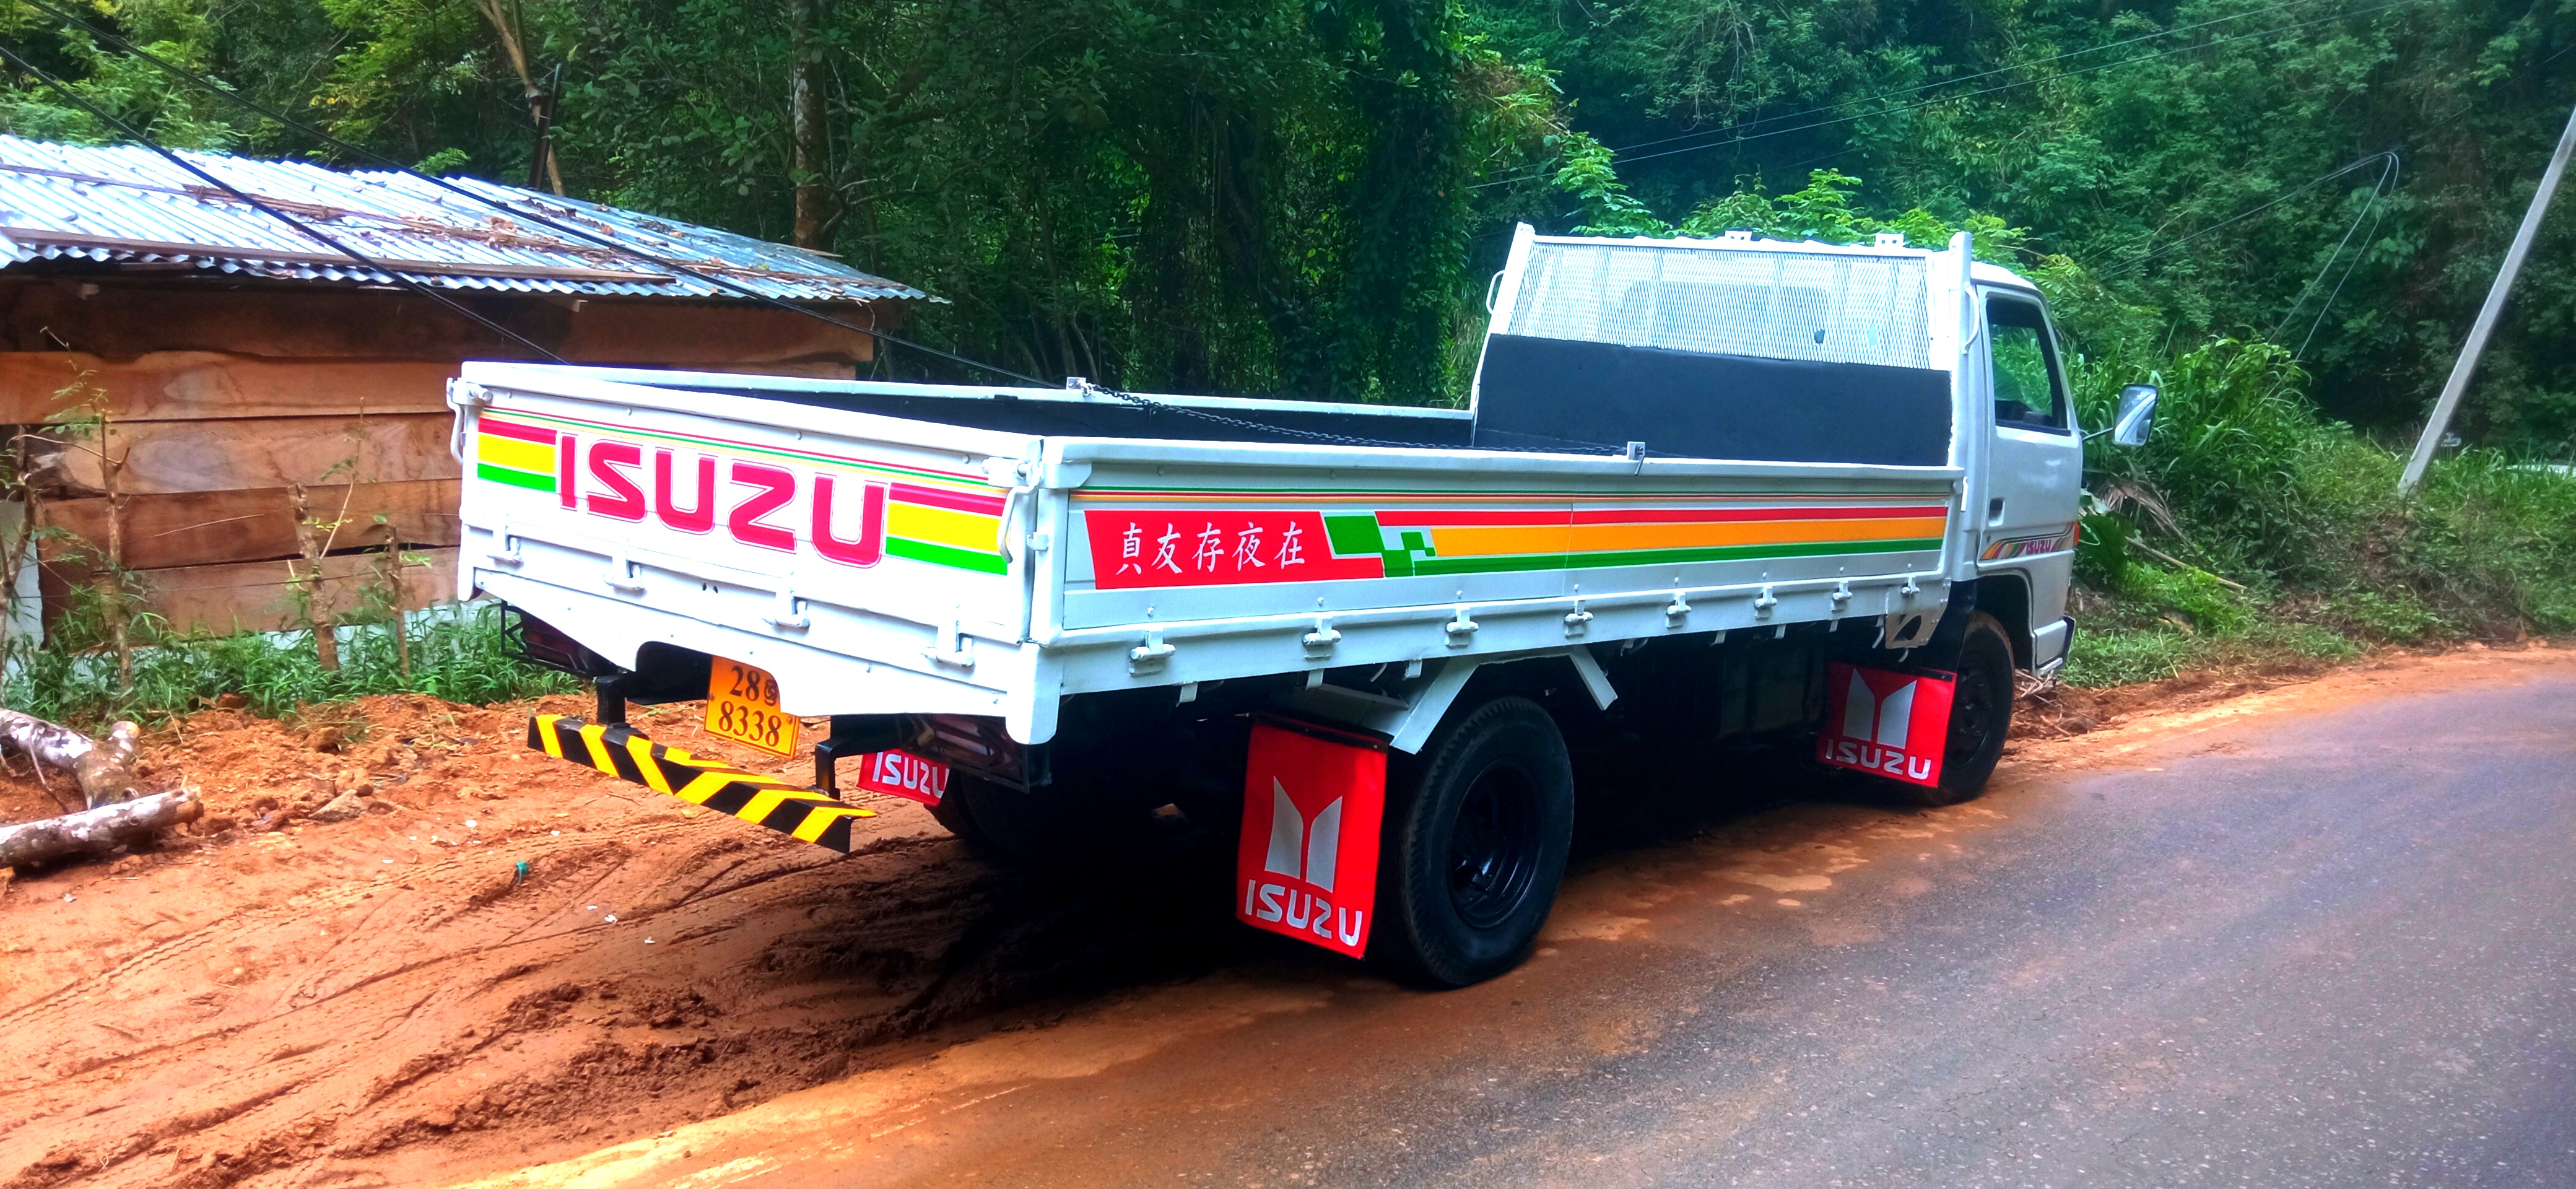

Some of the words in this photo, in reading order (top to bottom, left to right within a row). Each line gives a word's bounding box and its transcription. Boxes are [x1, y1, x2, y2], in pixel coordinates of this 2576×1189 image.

[559, 430, 889, 568] ISUZU
[2026, 539, 2052, 555] ISUZU
[729, 665, 760, 702] 28
[718, 700, 781, 747] 8338
[872, 751, 950, 799] ISUZU
[1825, 739, 1931, 780] ISUZU
[1245, 879, 1362, 946] ISUZU
